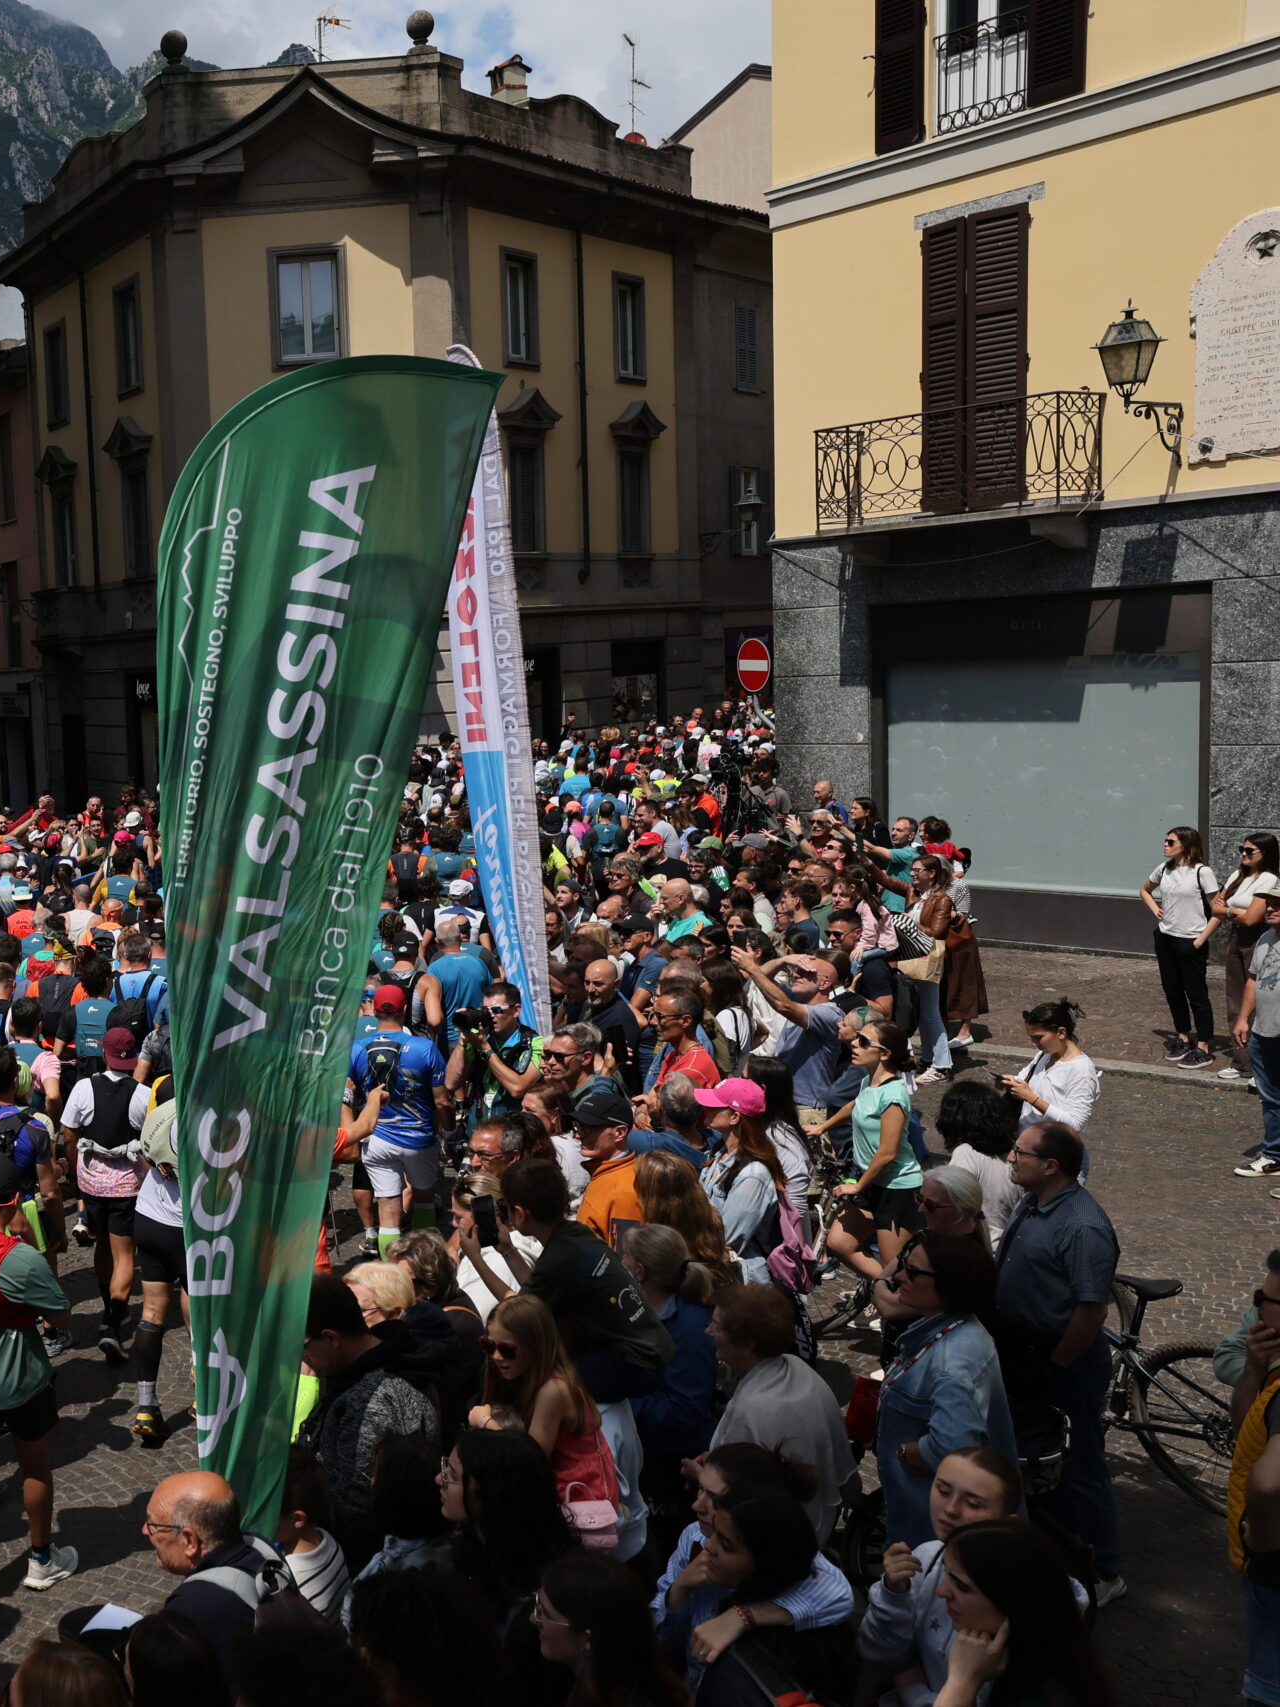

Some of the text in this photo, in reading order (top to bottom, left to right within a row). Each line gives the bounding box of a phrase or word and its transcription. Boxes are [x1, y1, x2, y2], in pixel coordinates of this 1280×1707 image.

[192, 630, 225, 751] SOSTEGNO,
[212, 507, 243, 619] SVILUPPO
[523, 658, 535, 673] ve
[186, 464, 377, 1298] BCC VALSASSINA
[295, 753, 386, 1057] Banca dal 1910
[148, 1117, 166, 1141] deuter
